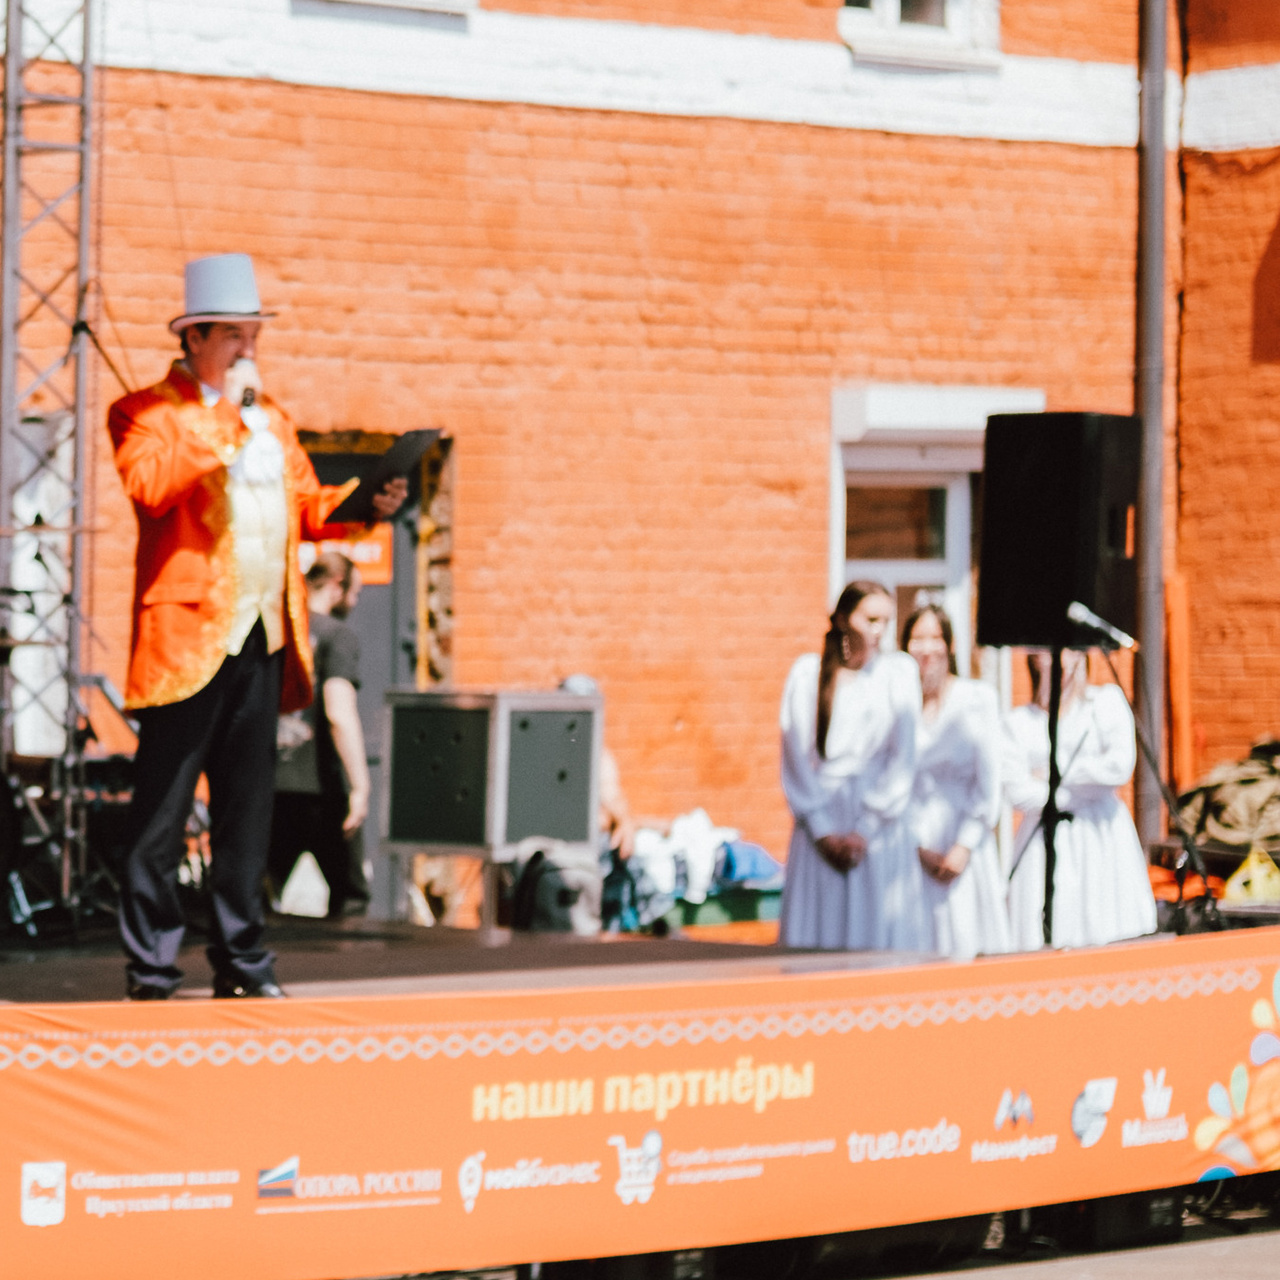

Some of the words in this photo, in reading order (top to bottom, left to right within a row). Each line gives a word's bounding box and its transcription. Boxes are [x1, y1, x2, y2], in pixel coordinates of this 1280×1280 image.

[473, 1078, 594, 1122] наши
[605, 1056, 815, 1121] партнёры
[846, 1117, 962, 1163] true.code
